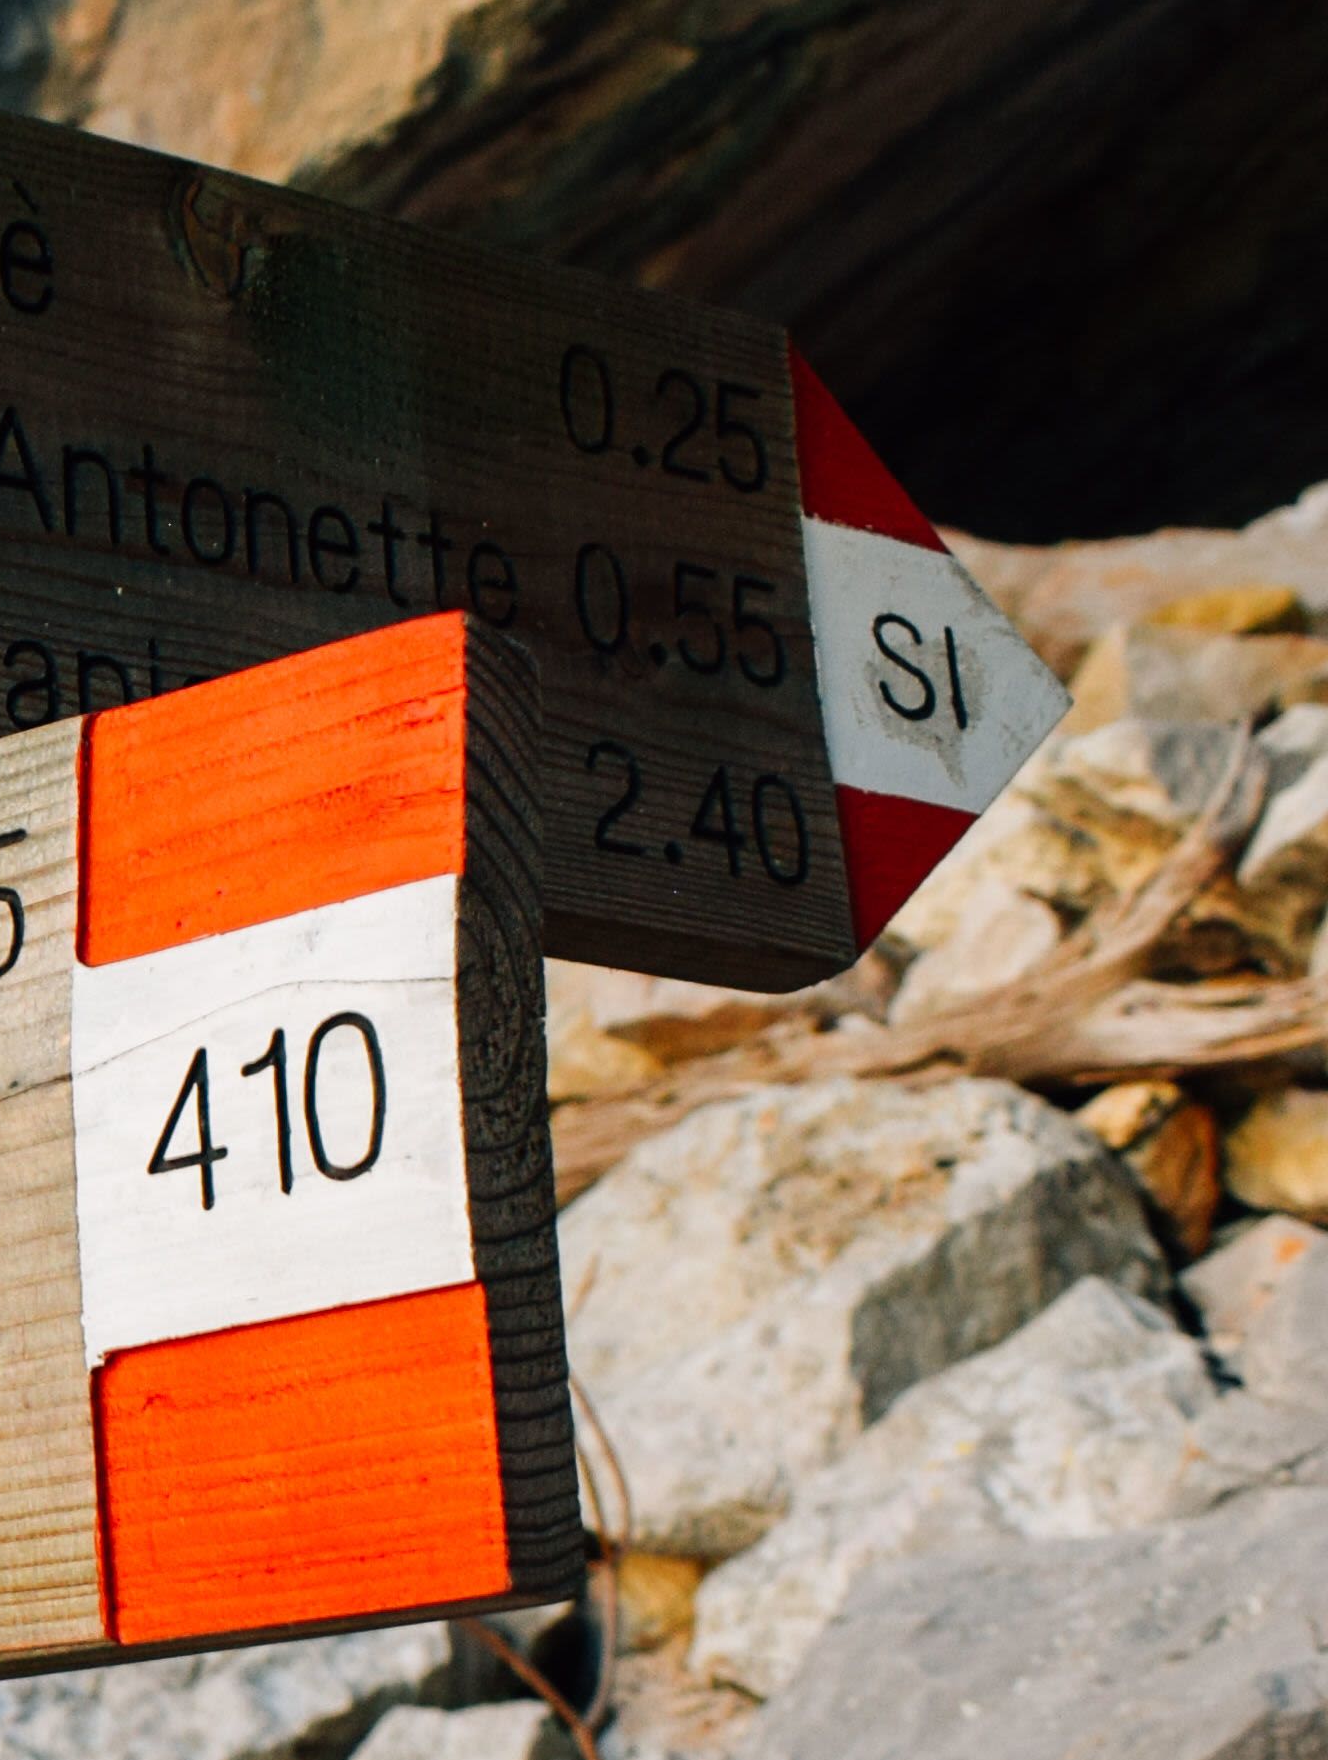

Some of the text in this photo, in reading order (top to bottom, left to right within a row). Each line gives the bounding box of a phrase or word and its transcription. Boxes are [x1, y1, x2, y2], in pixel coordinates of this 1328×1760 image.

[559, 344, 769, 493] 0.25
[575, 542, 788, 688] 0.55
[871, 612, 968, 731] SI
[586, 740, 810, 886] 2.40
[147, 1011, 387, 1210] 410
